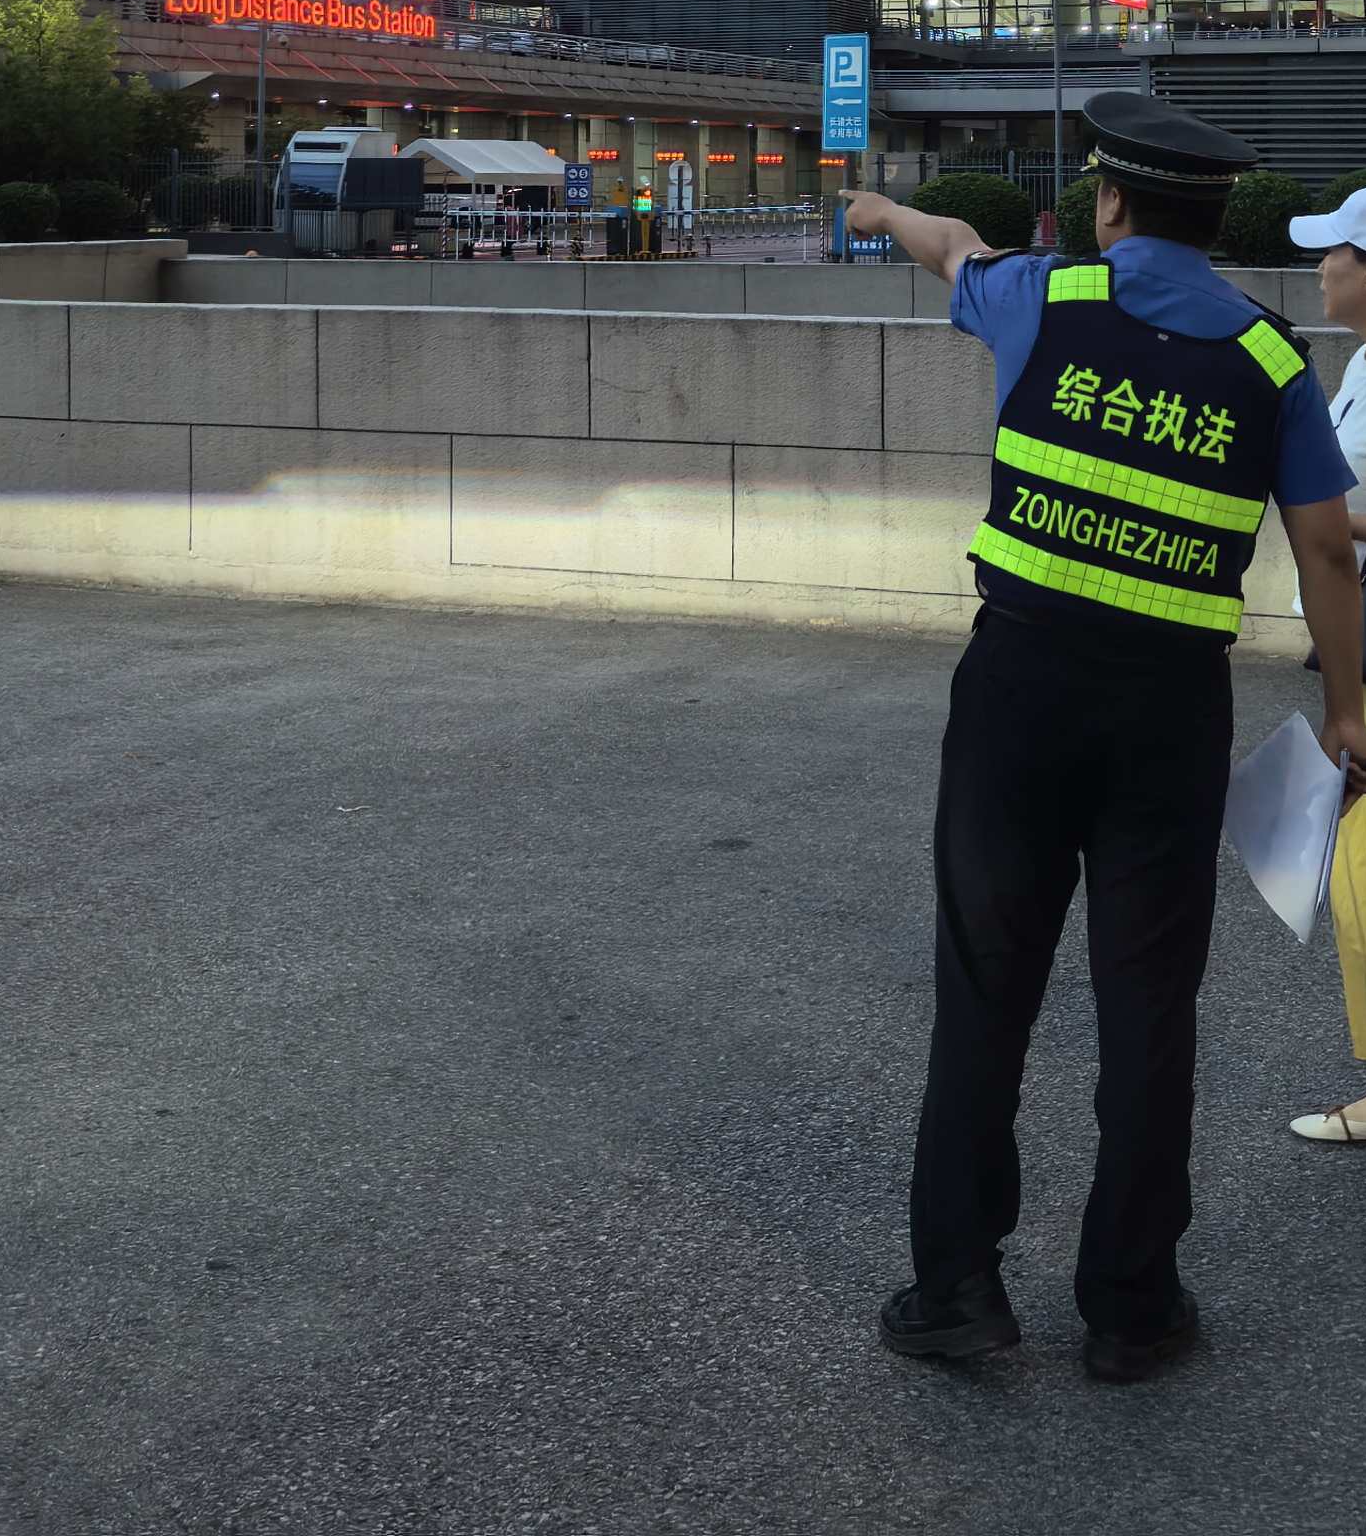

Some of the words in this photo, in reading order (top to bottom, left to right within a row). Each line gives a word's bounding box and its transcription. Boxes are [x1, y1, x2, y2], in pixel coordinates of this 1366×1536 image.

[368, 0, 435, 37] Station
[834, 51, 854, 83] P
[1051, 363, 1236, 464] 综合执法
[1008, 486, 1219, 578] ZONGHEZHIFA
